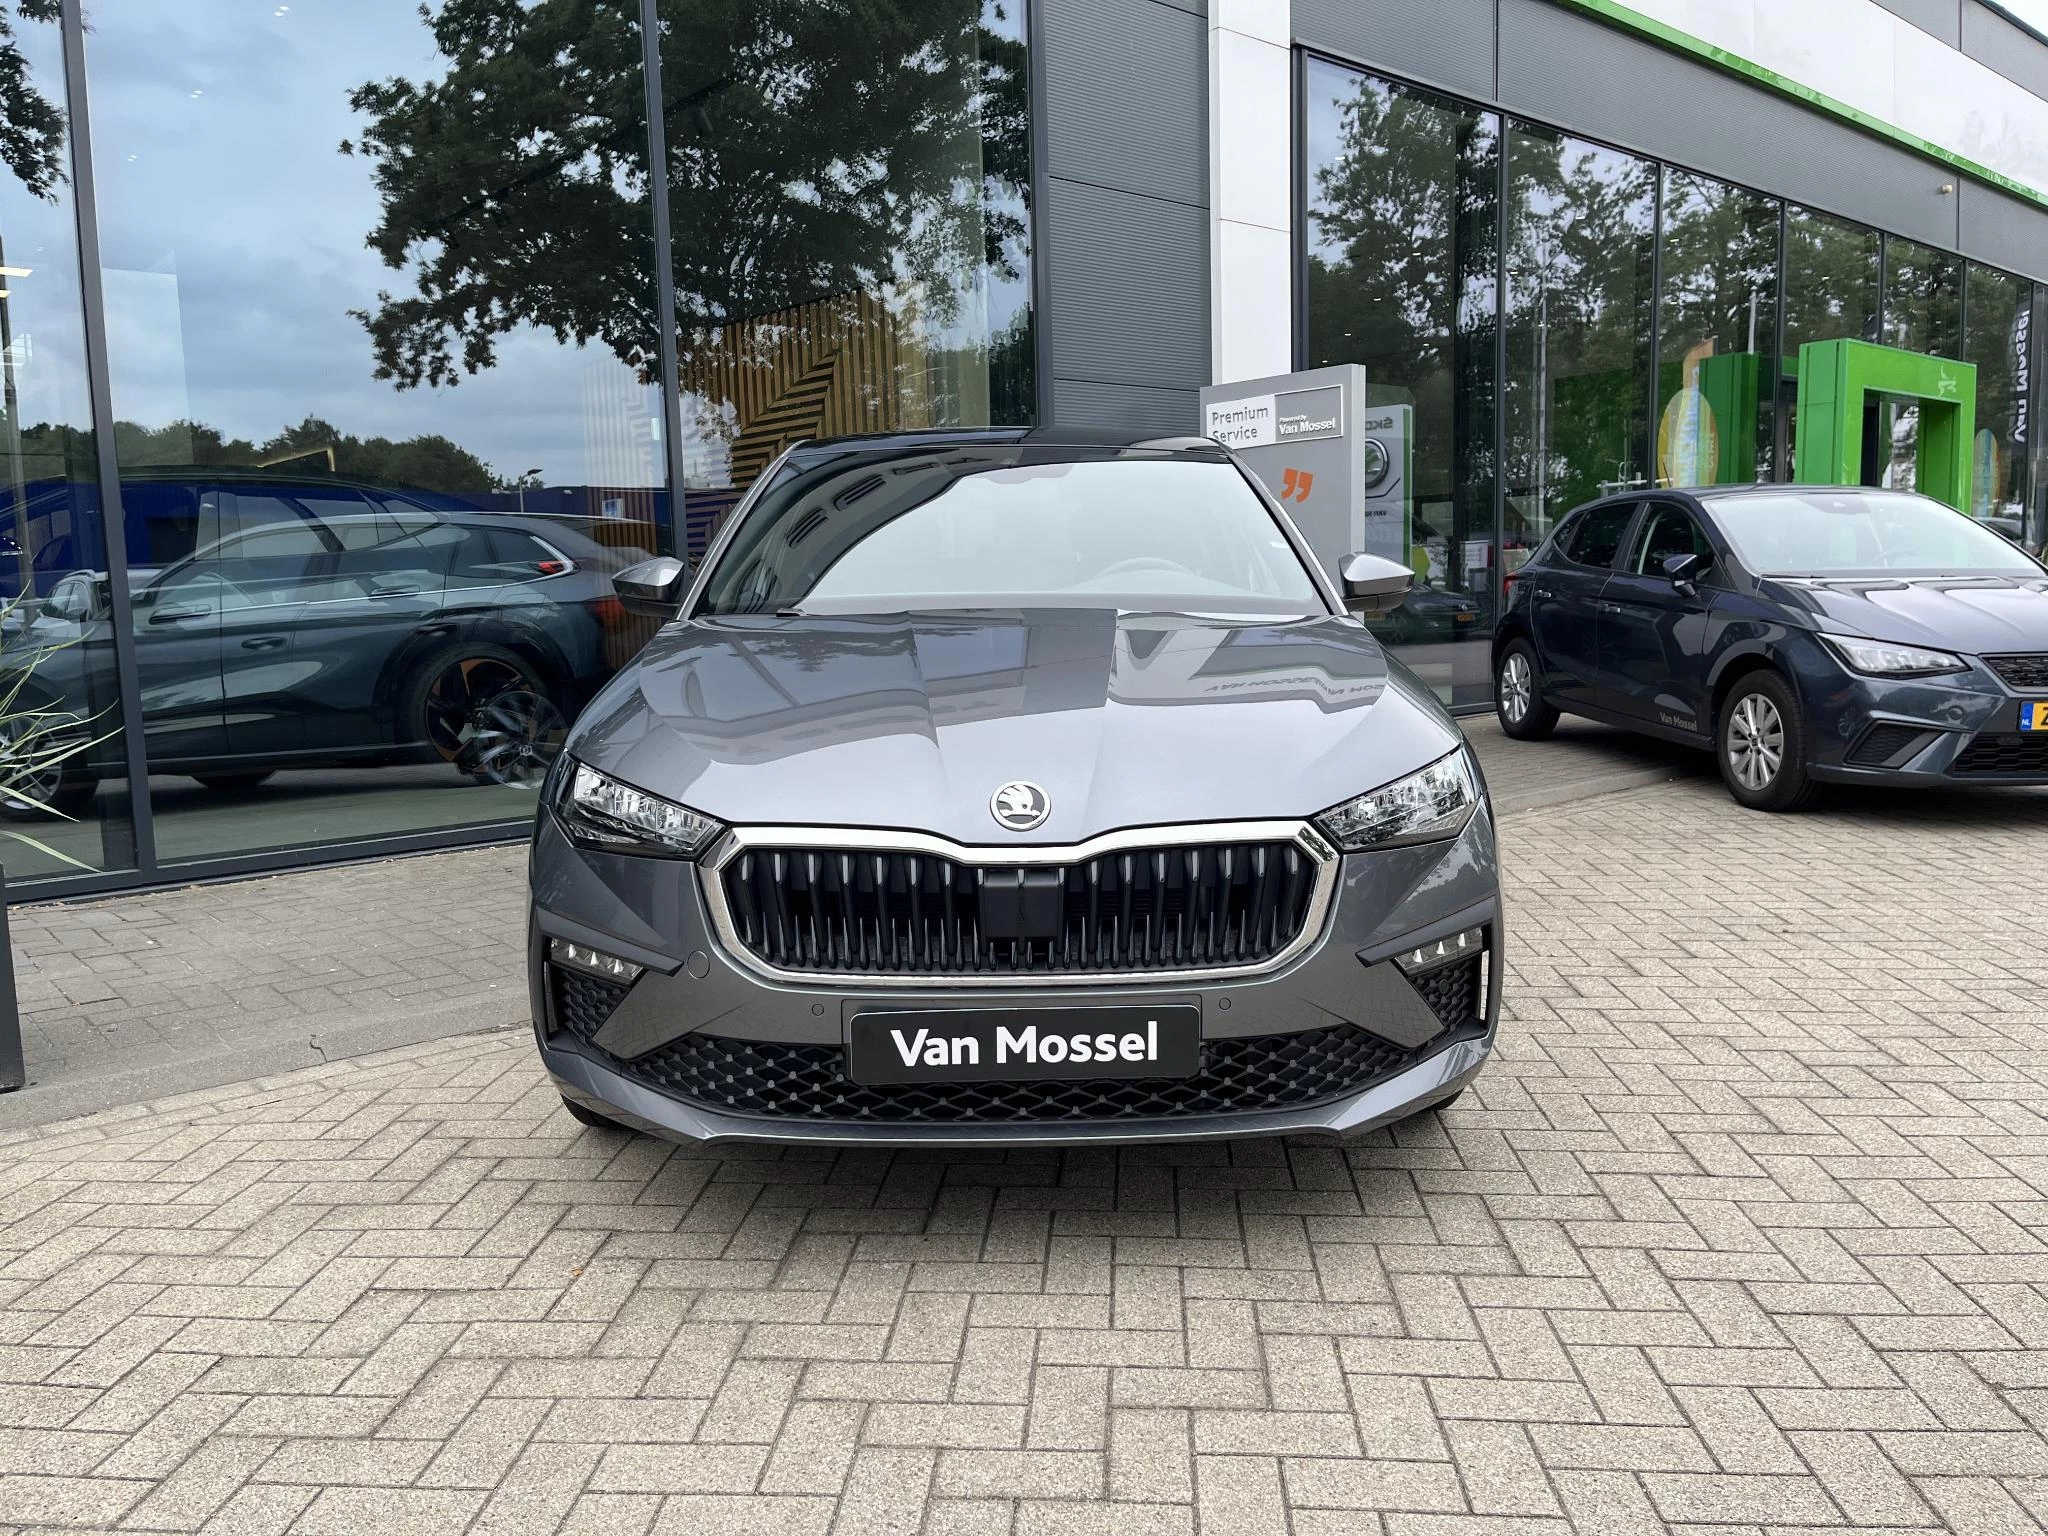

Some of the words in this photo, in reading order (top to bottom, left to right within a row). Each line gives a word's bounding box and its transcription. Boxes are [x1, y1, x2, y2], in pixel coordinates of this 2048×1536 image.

[1211, 406, 1269, 426] Premium
[1213, 426, 1258, 442] Service
[1279, 424, 1298, 435] Van
[1300, 417, 1336, 432] Mossel
[1659, 711, 1673, 726] Van
[1673, 715, 1698, 732] Mossel
[2021, 718, 2031, 726] NL
[890, 1028, 979, 1067] Van
[996, 1020, 1158, 1064] Mossel
